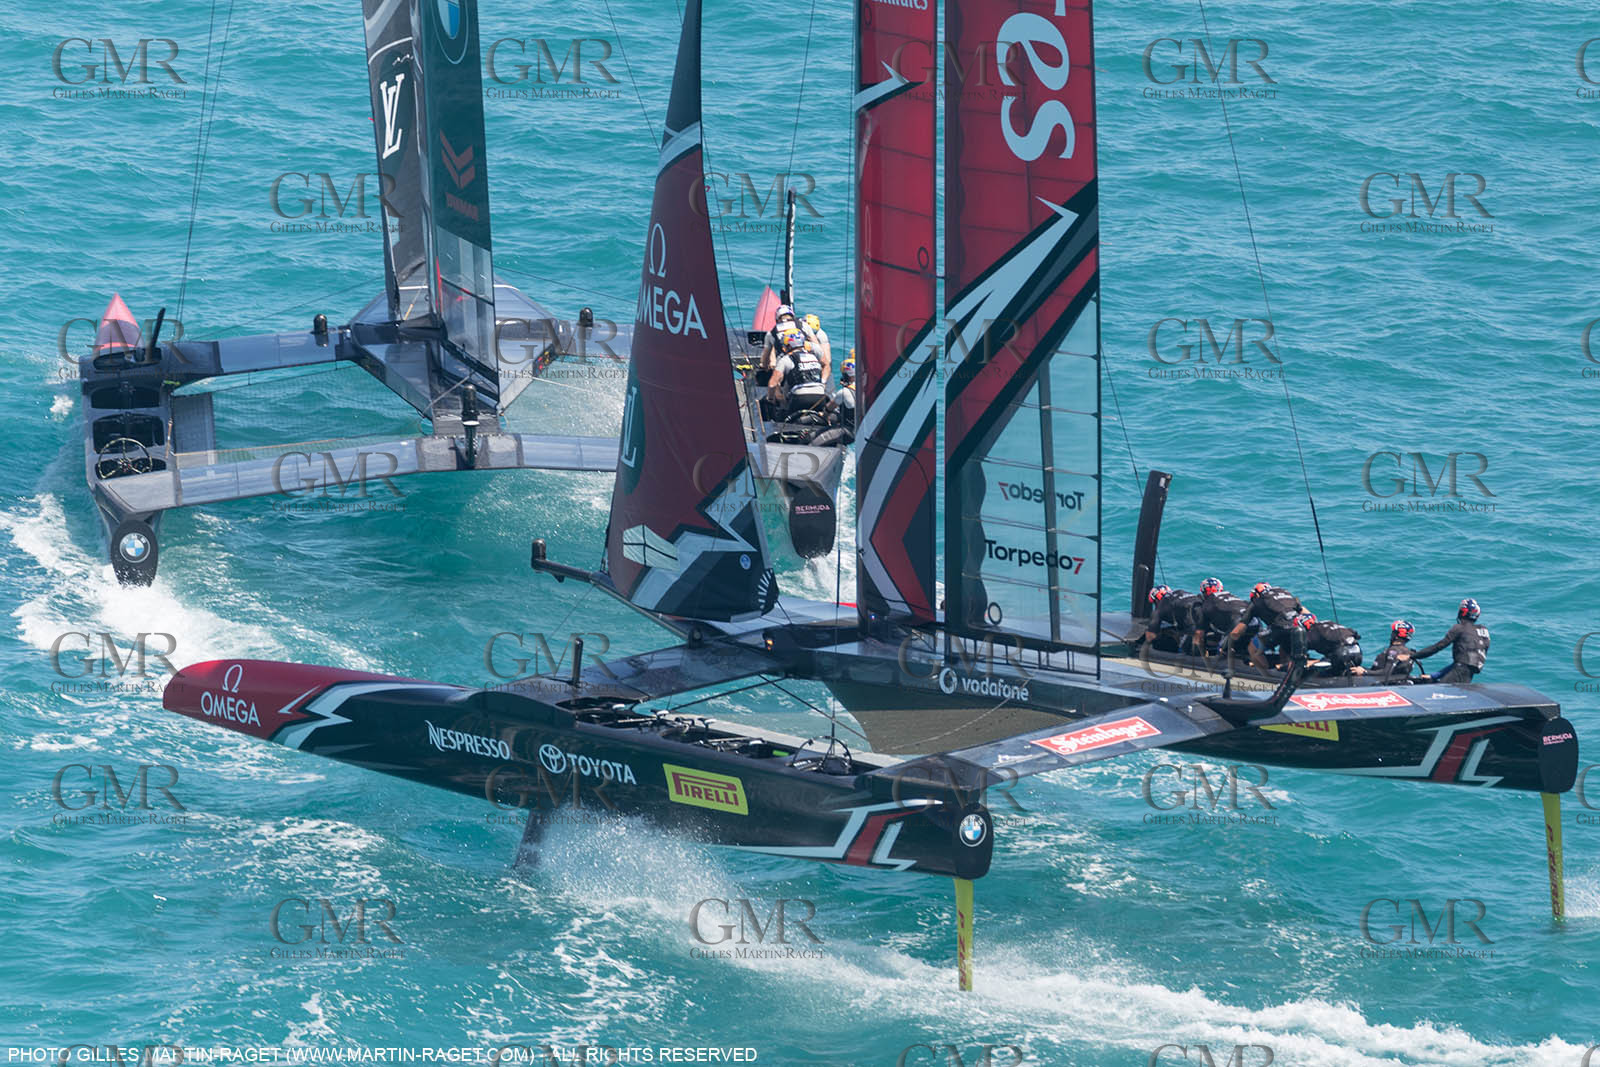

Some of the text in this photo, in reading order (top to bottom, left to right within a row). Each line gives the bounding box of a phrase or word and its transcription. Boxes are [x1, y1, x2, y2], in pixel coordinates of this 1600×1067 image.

[984, 539, 1085, 575] Torpedo7
[961, 677, 1029, 701] vodafone
[201, 691, 261, 727] OMEGA
[424, 720, 511, 760] NESPRESSO
[567, 753, 638, 785] TOYOTA
[671, 772, 740, 806] PIRELLI
